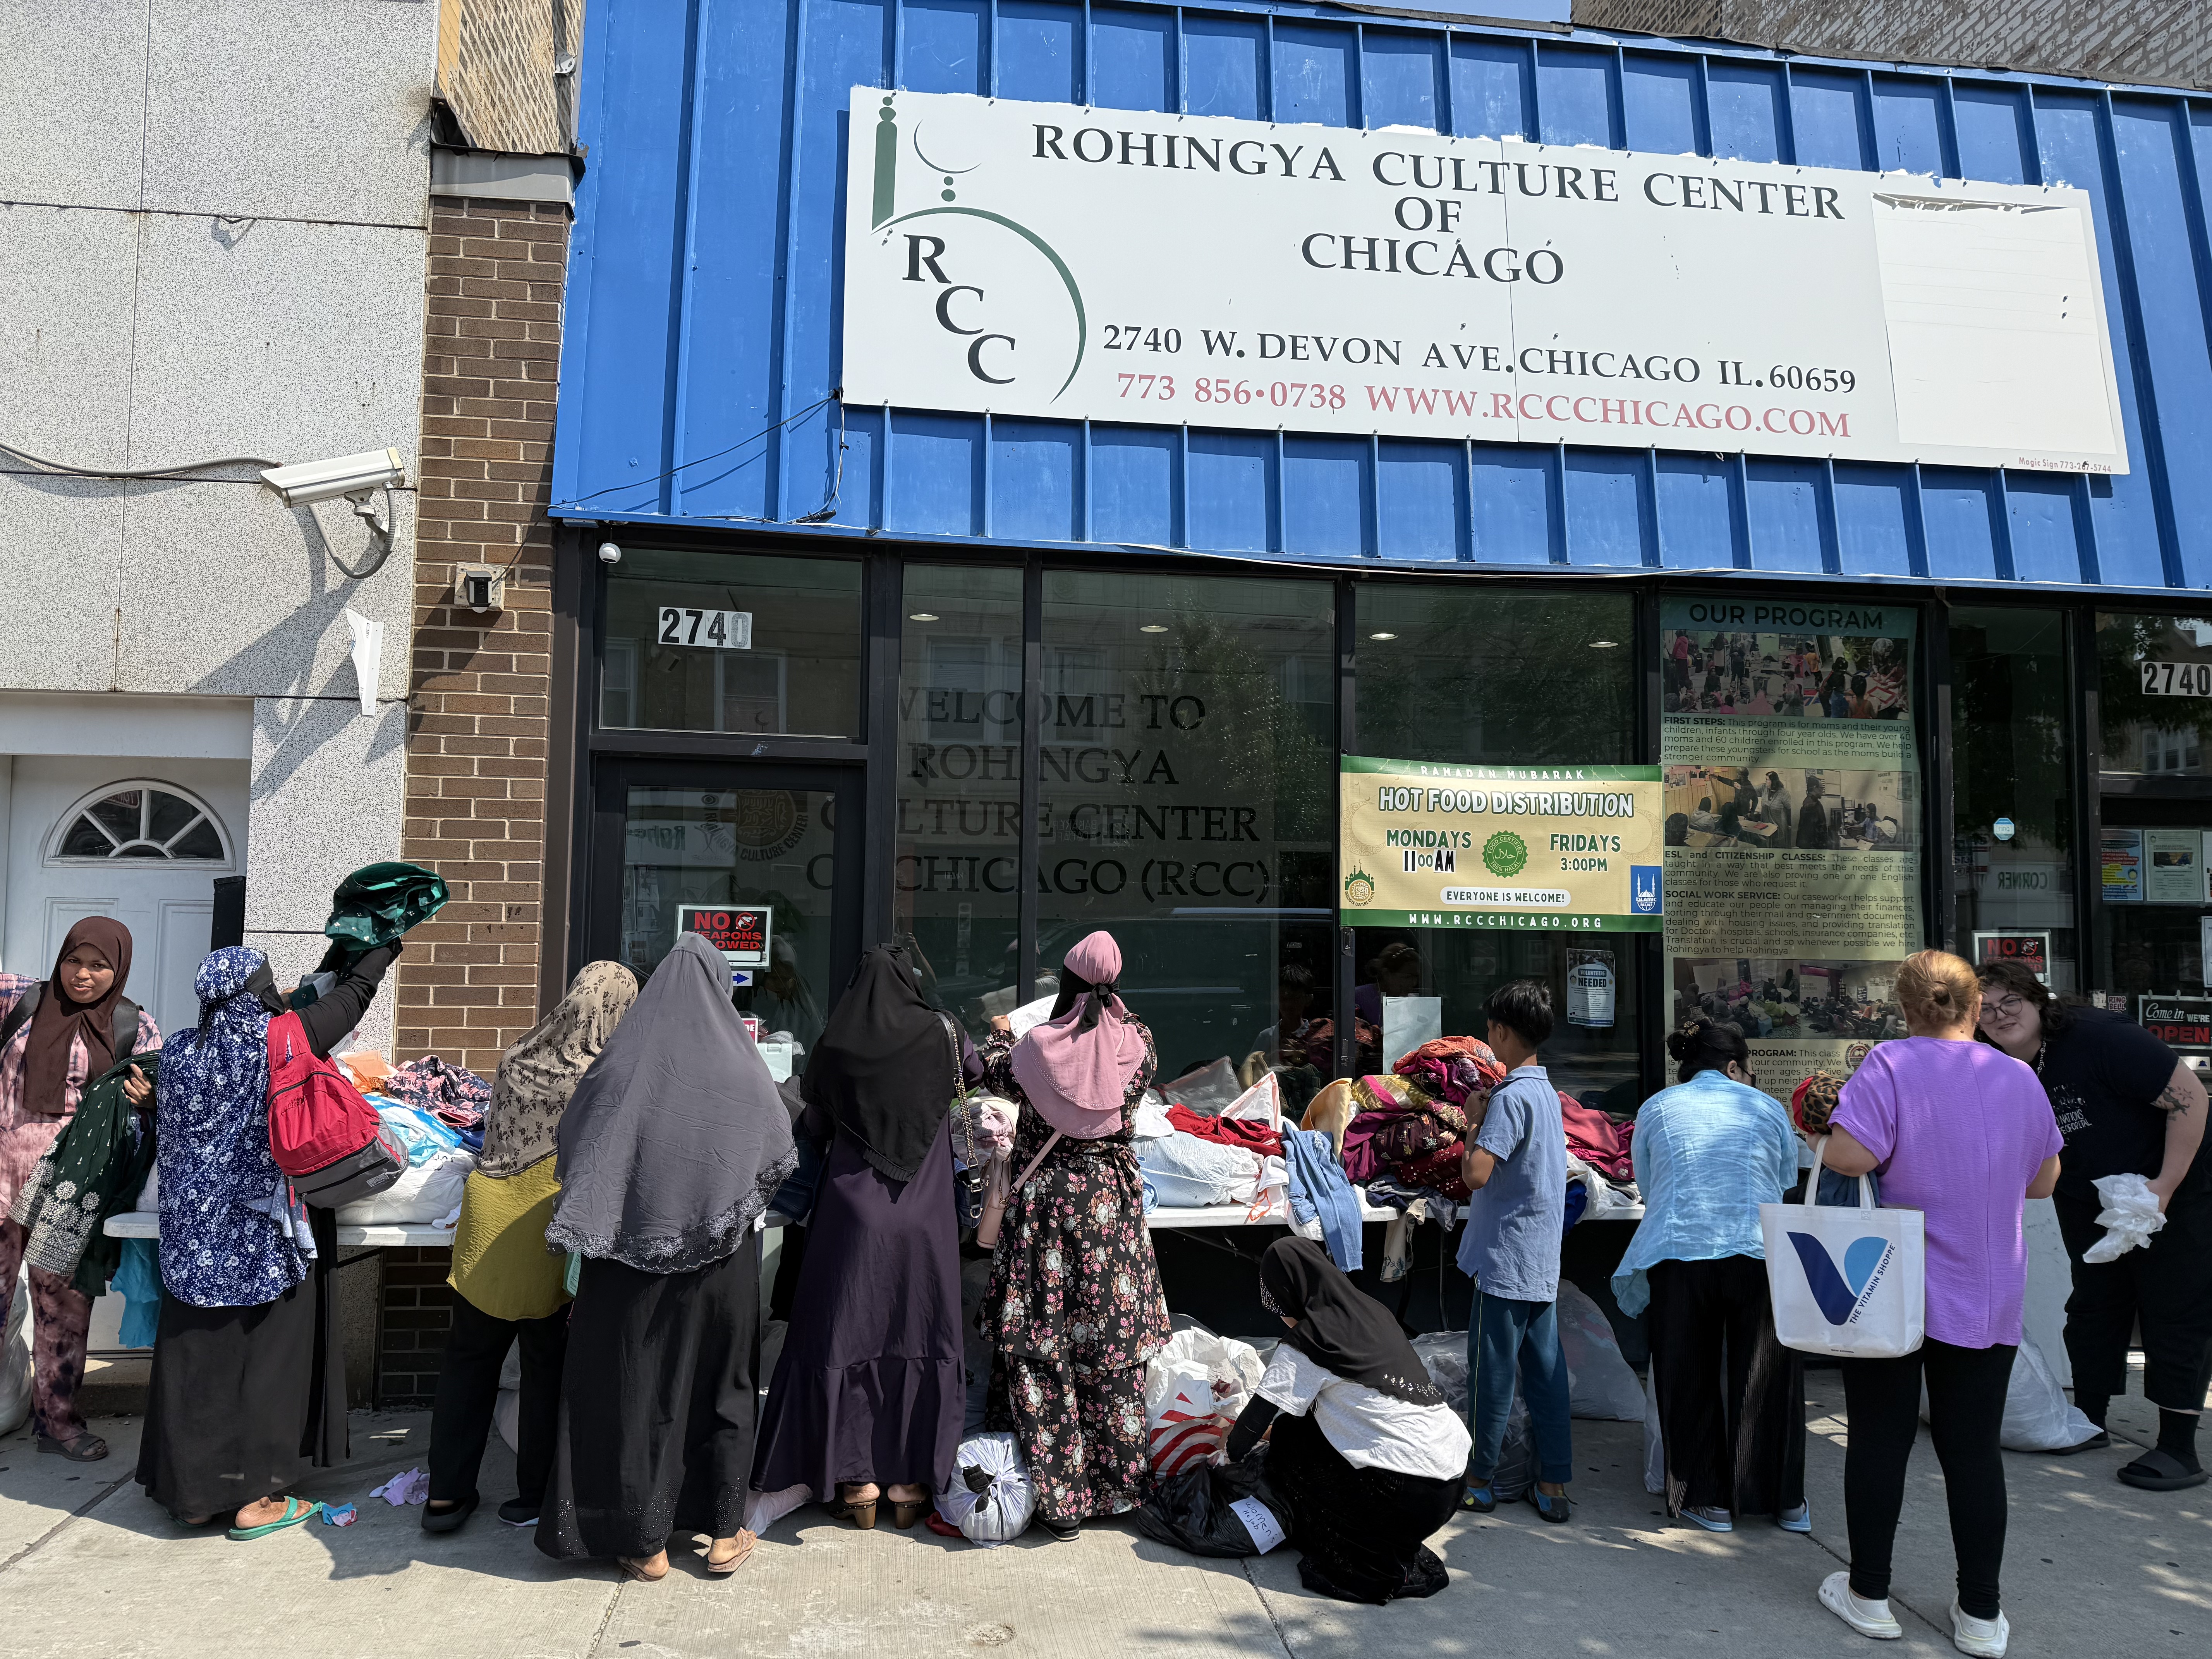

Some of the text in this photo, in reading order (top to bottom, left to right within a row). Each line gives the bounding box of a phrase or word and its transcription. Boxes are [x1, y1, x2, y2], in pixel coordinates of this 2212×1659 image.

[1033, 122, 1845, 219] ROHINGYA CULTURE CENTER
[1395, 197, 1461, 233] OF
[1302, 232, 1563, 284] CHICAGO
[1104, 325, 1181, 353] 2740
[1200, 330, 1244, 357] W.
[1259, 333, 1401, 365] DEVON
[1118, 373, 1175, 400] 773
[1366, 386, 1849, 438] WWW.RCCCHICAGO.COM
[2019, 457, 2040, 467] Magic
[2043, 459, 2058, 469] Sign
[1689, 604, 1882, 629] OUR PROGRAM
[661, 609, 749, 648] 2740
[2144, 663, 2211, 696] 2740
[1140, 694, 1206, 730] TO
[1664, 726, 1703, 734] children,
[1739, 728, 1775, 737] through
[1893, 742, 1911, 750] help
[907, 742, 1179, 785] ROHNGYA
[1707, 755, 1761, 763] community.
[1421, 766, 1584, 779] RAMADAN MUBARAK
[1379, 787, 1634, 818] HOT FOOD DISTRIBUTION
[1070, 803, 1260, 842] CENTER
[740, 844, 787, 861] CULTURE
[785, 814, 809, 849] CENTER
[1387, 830, 1621, 852] MONDAYS FRIDAYS
[1488, 836, 1522, 854] FOOD CERTIFIED
[1495, 848, 1515, 859] حلال
[1491, 861, 1520, 872] 100% HALAL
[1561, 858, 1607, 871] 3:00PM
[1142, 858, 1269, 905] (RCC)
[1447, 891, 1565, 903] EVERYONE IS WELCOME!
[694, 912, 730, 930] NO
[1409, 914, 1601, 928] WWW.RCCCHICAGO.ORG
[689, 931, 762, 940] EAPONS
[715, 941, 759, 949] OWED
[1667, 945, 1709, 954] Rohingya
[1724, 946, 1743, 955] help
[1987, 939, 2016, 955] NO
[1578, 977, 1606, 987] NEEDED
[2146, 1003, 2210, 1023] Come in WE'RE
[2148, 1025, 2210, 1043] OPEN
[1772, 1059, 1825, 1067] community.
[2059, 1109, 2083, 1125] NATIONS
[1850, 1244, 1895, 1324] THE VITAMIN SHOPPE
